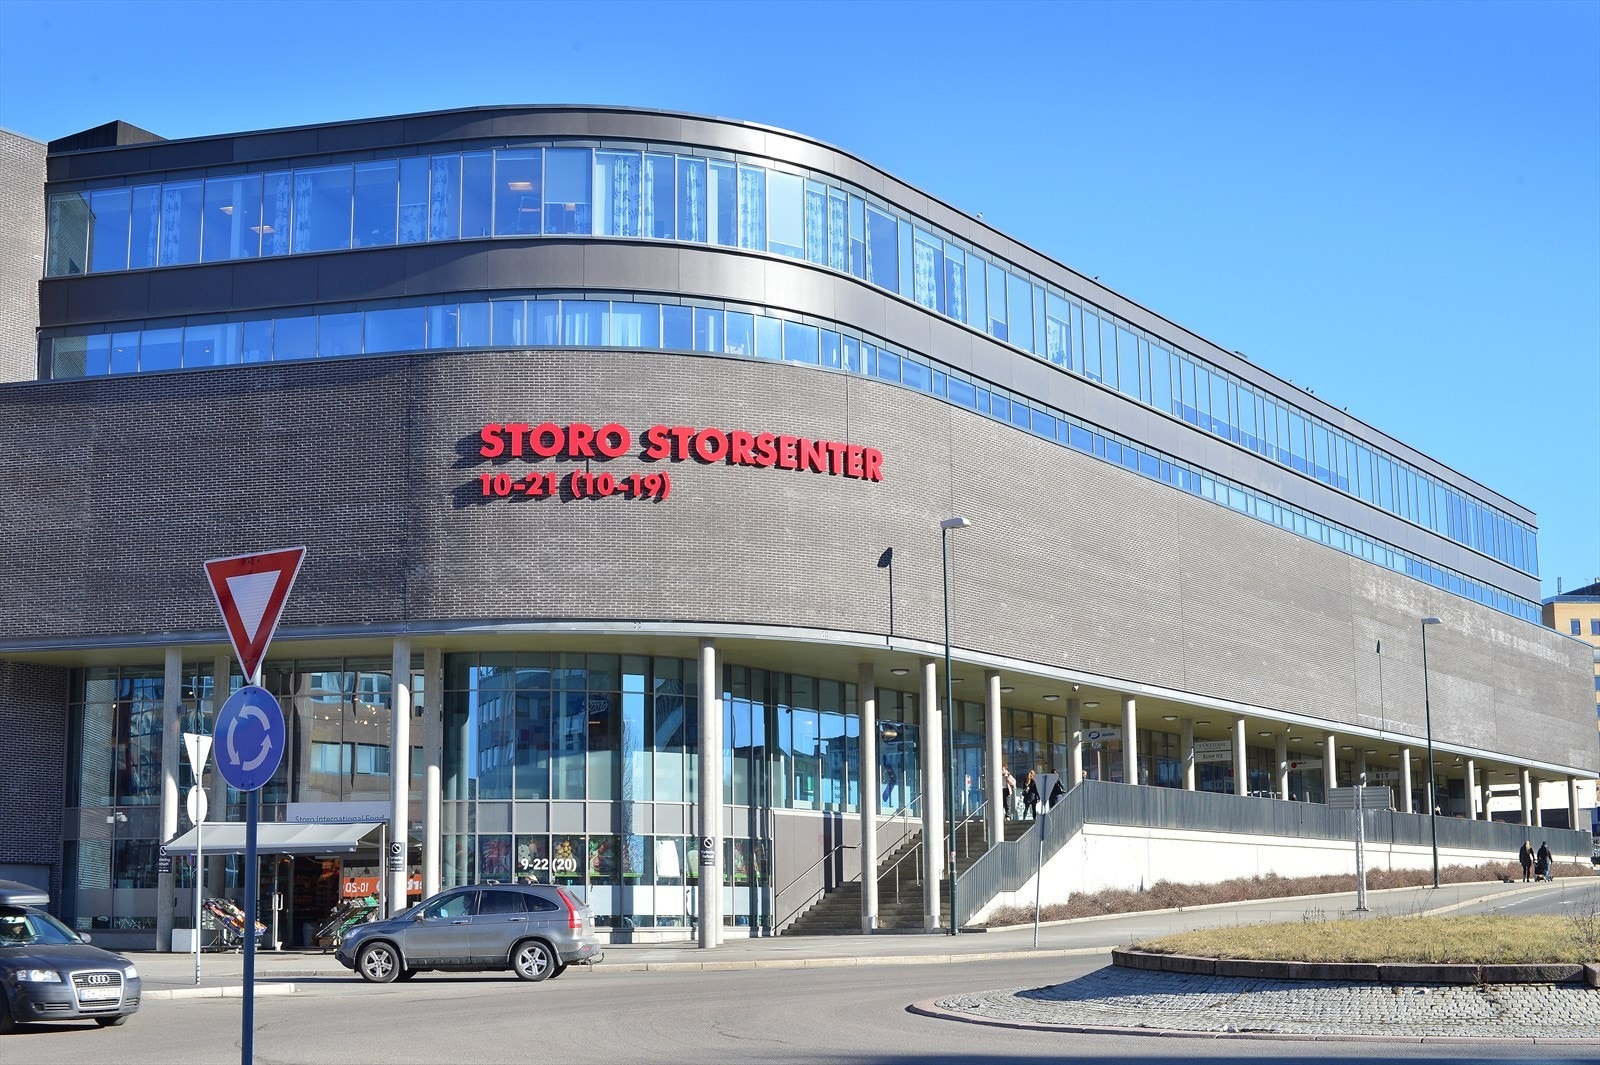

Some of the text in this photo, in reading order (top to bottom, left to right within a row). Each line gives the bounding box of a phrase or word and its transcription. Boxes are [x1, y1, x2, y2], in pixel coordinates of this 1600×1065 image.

[479, 422, 884, 481] STORO STORSENTER
[479, 469, 672, 500] 10-21 (10-19)
[295, 815, 315, 823] Storo
[316, 814, 364, 822] International
[520, 858, 577, 872] 9-22 (20)
